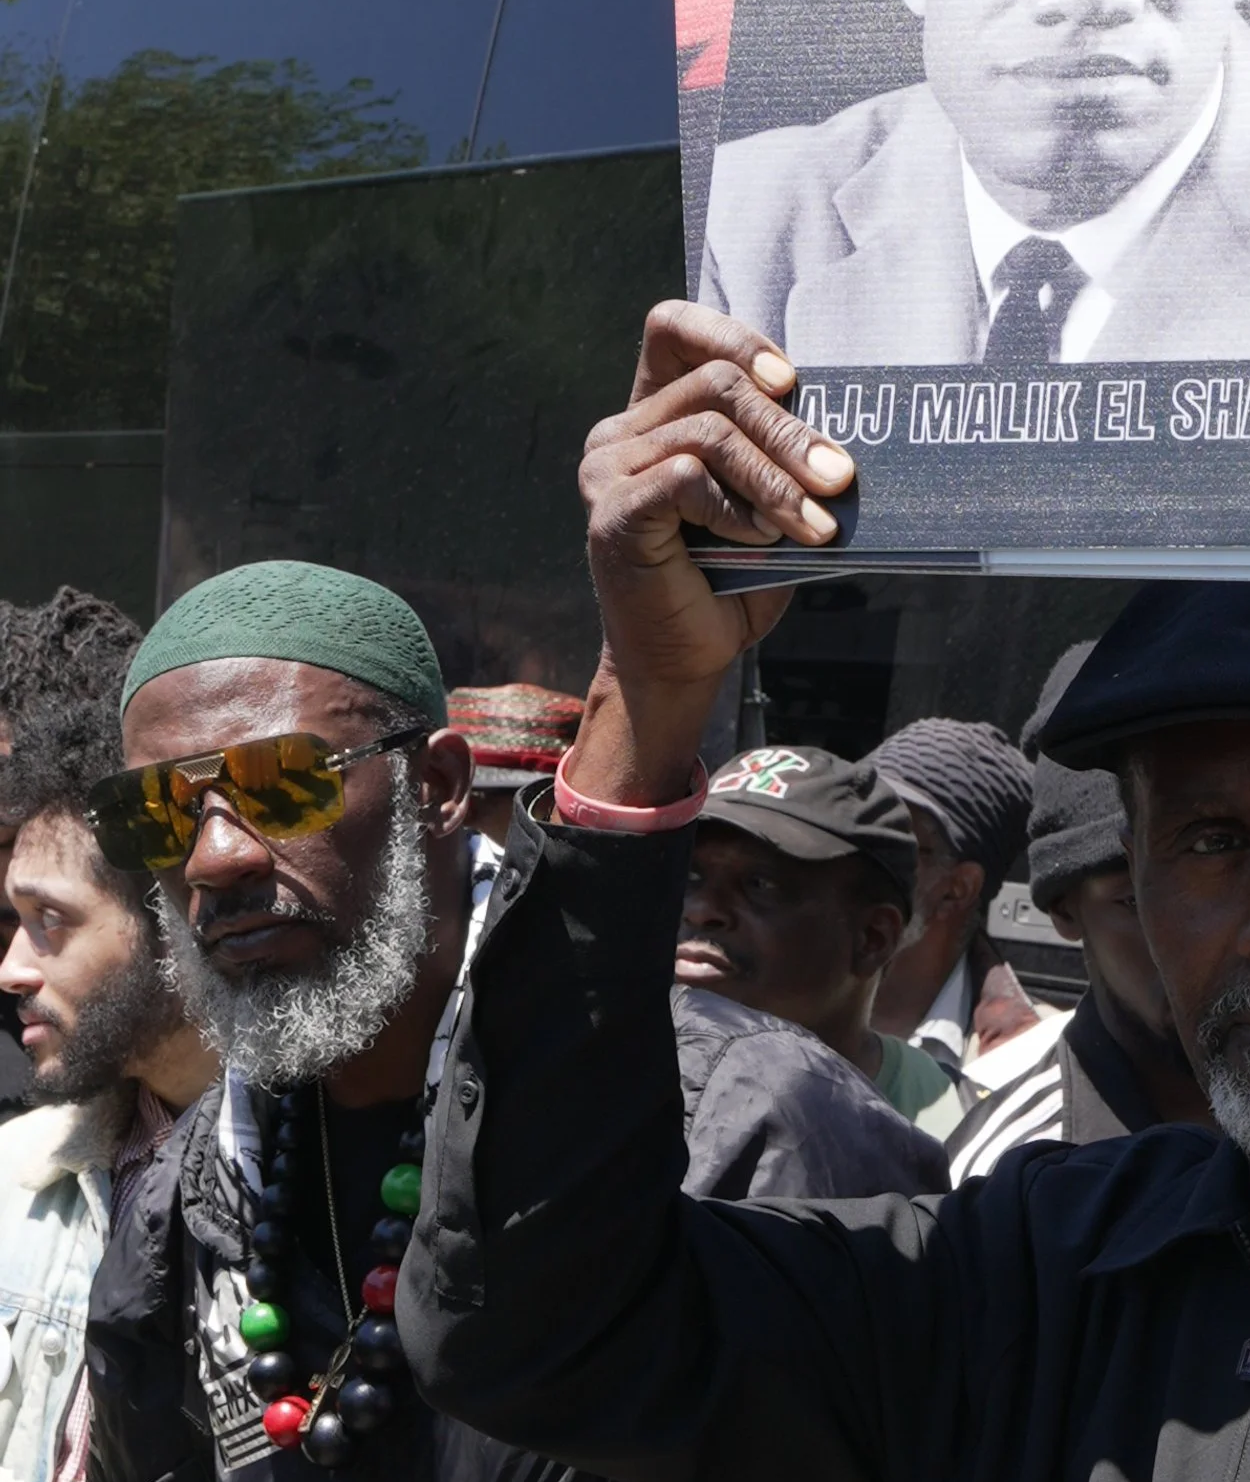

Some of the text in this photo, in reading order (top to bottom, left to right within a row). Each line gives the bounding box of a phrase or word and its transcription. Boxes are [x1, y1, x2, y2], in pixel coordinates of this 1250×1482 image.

[793, 384, 896, 444] AJJ
[909, 381, 1082, 444] MALIK
[1094, 380, 1156, 442] EL
[709, 749, 810, 799] X
